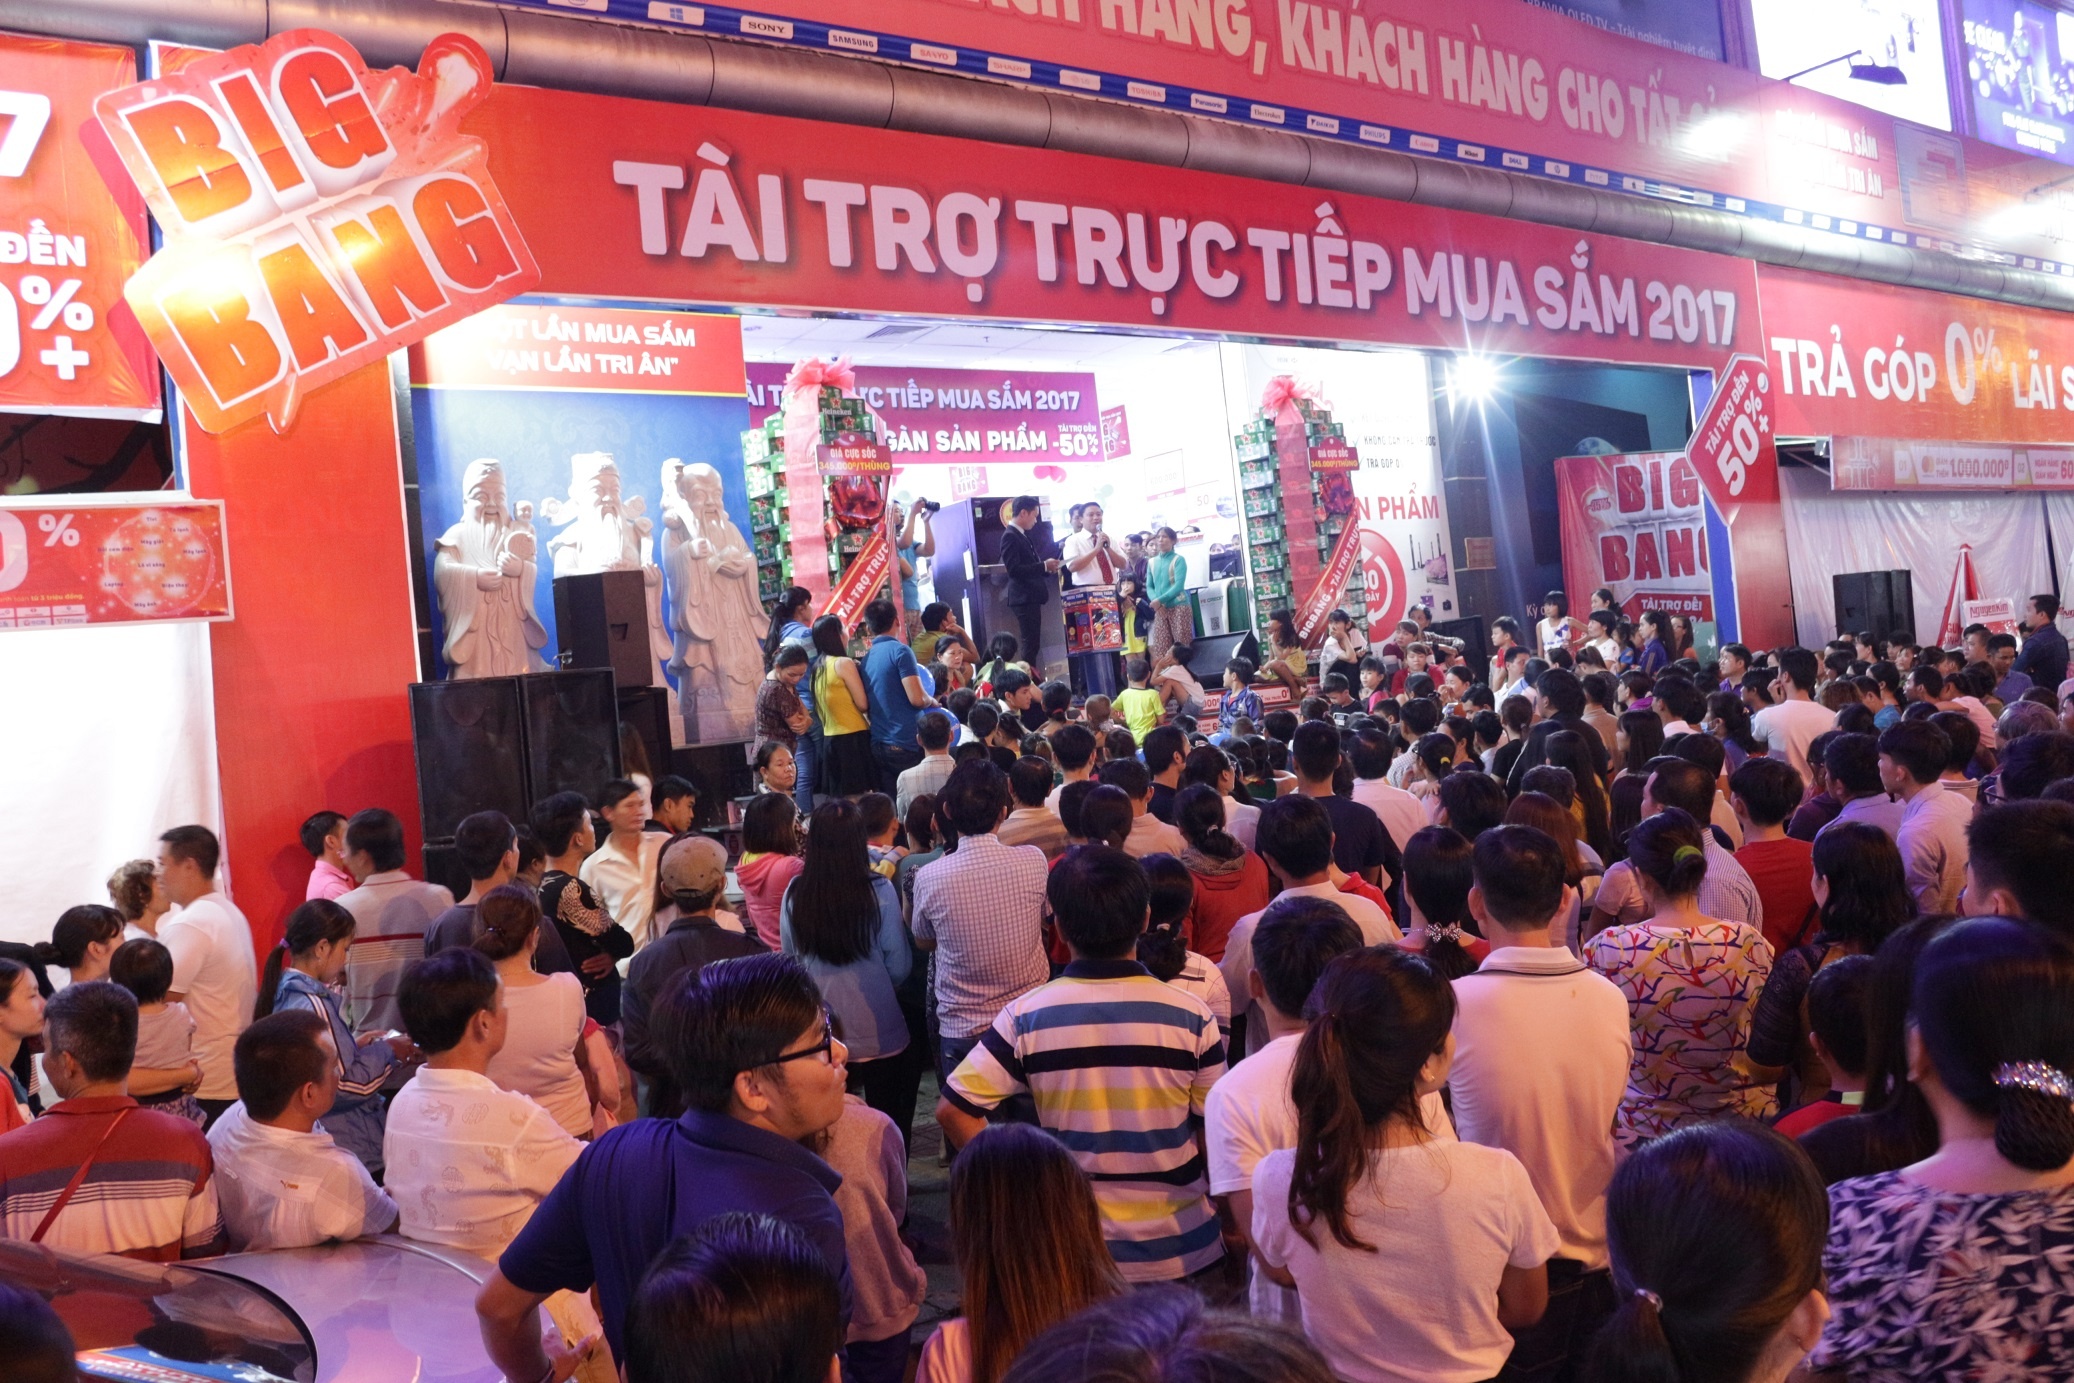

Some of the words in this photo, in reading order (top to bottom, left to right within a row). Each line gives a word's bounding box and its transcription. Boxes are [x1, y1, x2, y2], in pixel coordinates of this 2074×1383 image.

[748, 21, 785, 34] SONY
[832, 35, 875, 49] SAMSUNG
[993, 61, 1027, 73] SHARP
[1278, 0, 1428, 95] KHÁCH
[1439, 24, 1548, 121] HÀNG
[1558, 67, 1625, 139] CHO
[1131, 86, 1162, 98] TOSHIBA
[1195, 98, 1224, 110] Panasonic
[1254, 109, 1282, 120] Electrolux
[118, 47, 397, 223] BIG
[1364, 129, 1387, 140] PHILIPS
[613, 142, 788, 263] TÀI
[803, 178, 1000, 302] TRỢ
[1015, 200, 1238, 315] TRỰC
[1247, 201, 1392, 310] TIẾP
[1403, 247, 1529, 325] MUA
[1533, 239, 1639, 337] SẮM
[1646, 281, 1735, 345] 2017
[155, 173, 522, 410] BANG
[531, 313, 580, 343] LẦN
[586, 323, 640, 345] MUA
[644, 320, 696, 347] SẮM
[544, 343, 592, 374] LẦN
[595, 353, 634, 375] TRI
[1770, 324, 1857, 398] TRẢ
[1863, 334, 1937, 403] GÓP
[2010, 349, 2056, 411] LÃI
[886, 378, 934, 409] TIẾP
[938, 388, 985, 410] MUA
[987, 380, 1032, 410] SẮM
[1035, 390, 1080, 410] 2017
[822, 407, 852, 416] Heineken
[1705, 430, 1722, 456] TÀI
[1716, 403, 1736, 432] TRỢ
[1730, 369, 1750, 406] ĐẾN
[884, 424, 929, 452] GÀN
[935, 424, 981, 452] SẢN
[988, 422, 1048, 451] PHẨM
[1058, 423, 1068, 433] TÀI
[830, 446, 843, 459] GIÁ
[845, 448, 860, 461] CỰC
[862, 446, 877, 459] SỐC
[1377, 482, 1440, 521] PHẨM
[1614, 457, 1700, 514] BIG
[1600, 526, 1710, 583] BAN
[837, 601, 857, 620] TÀI
[850, 575, 873, 600] TRỢ
[1299, 594, 1331, 640] BIGBANG
[1331, 570, 1343, 587] TÀI
[1641, 597, 1657, 611] TÀI
[1660, 599, 1681, 614] TRỢ
